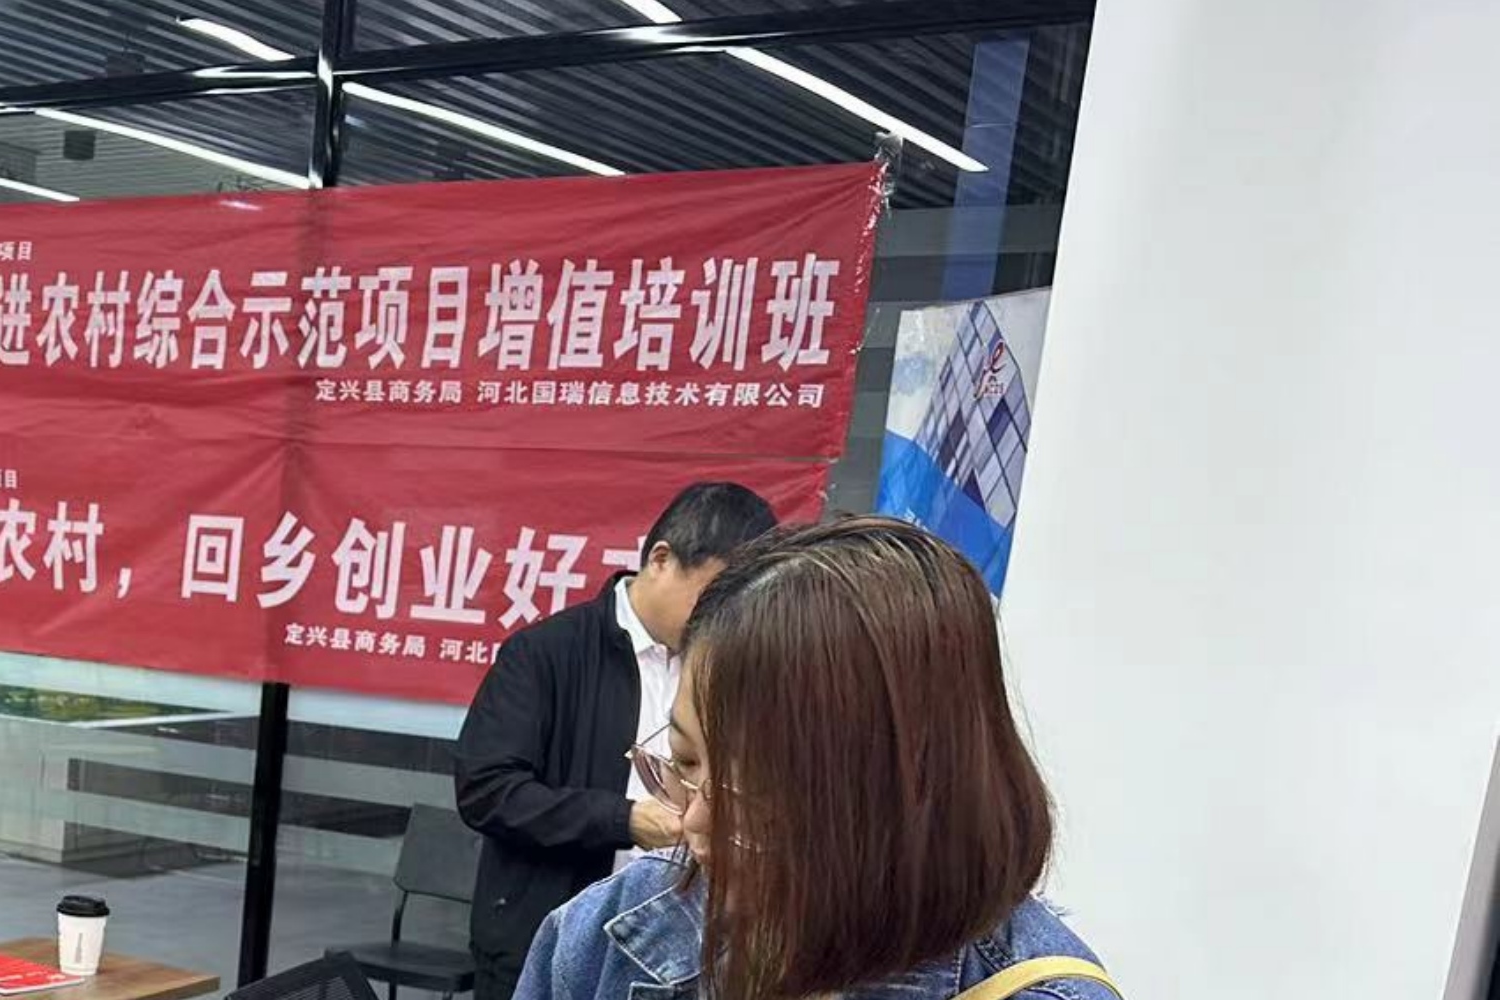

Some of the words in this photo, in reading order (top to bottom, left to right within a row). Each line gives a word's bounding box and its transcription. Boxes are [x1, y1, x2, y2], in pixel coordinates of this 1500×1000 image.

[315, 378, 463, 404] 定兴县商务局
[477, 380, 826, 409] 河北国瑞信息技术有限公司
[283, 622, 426, 659] 定兴县商务局
[439, 638, 501, 665] 河北
